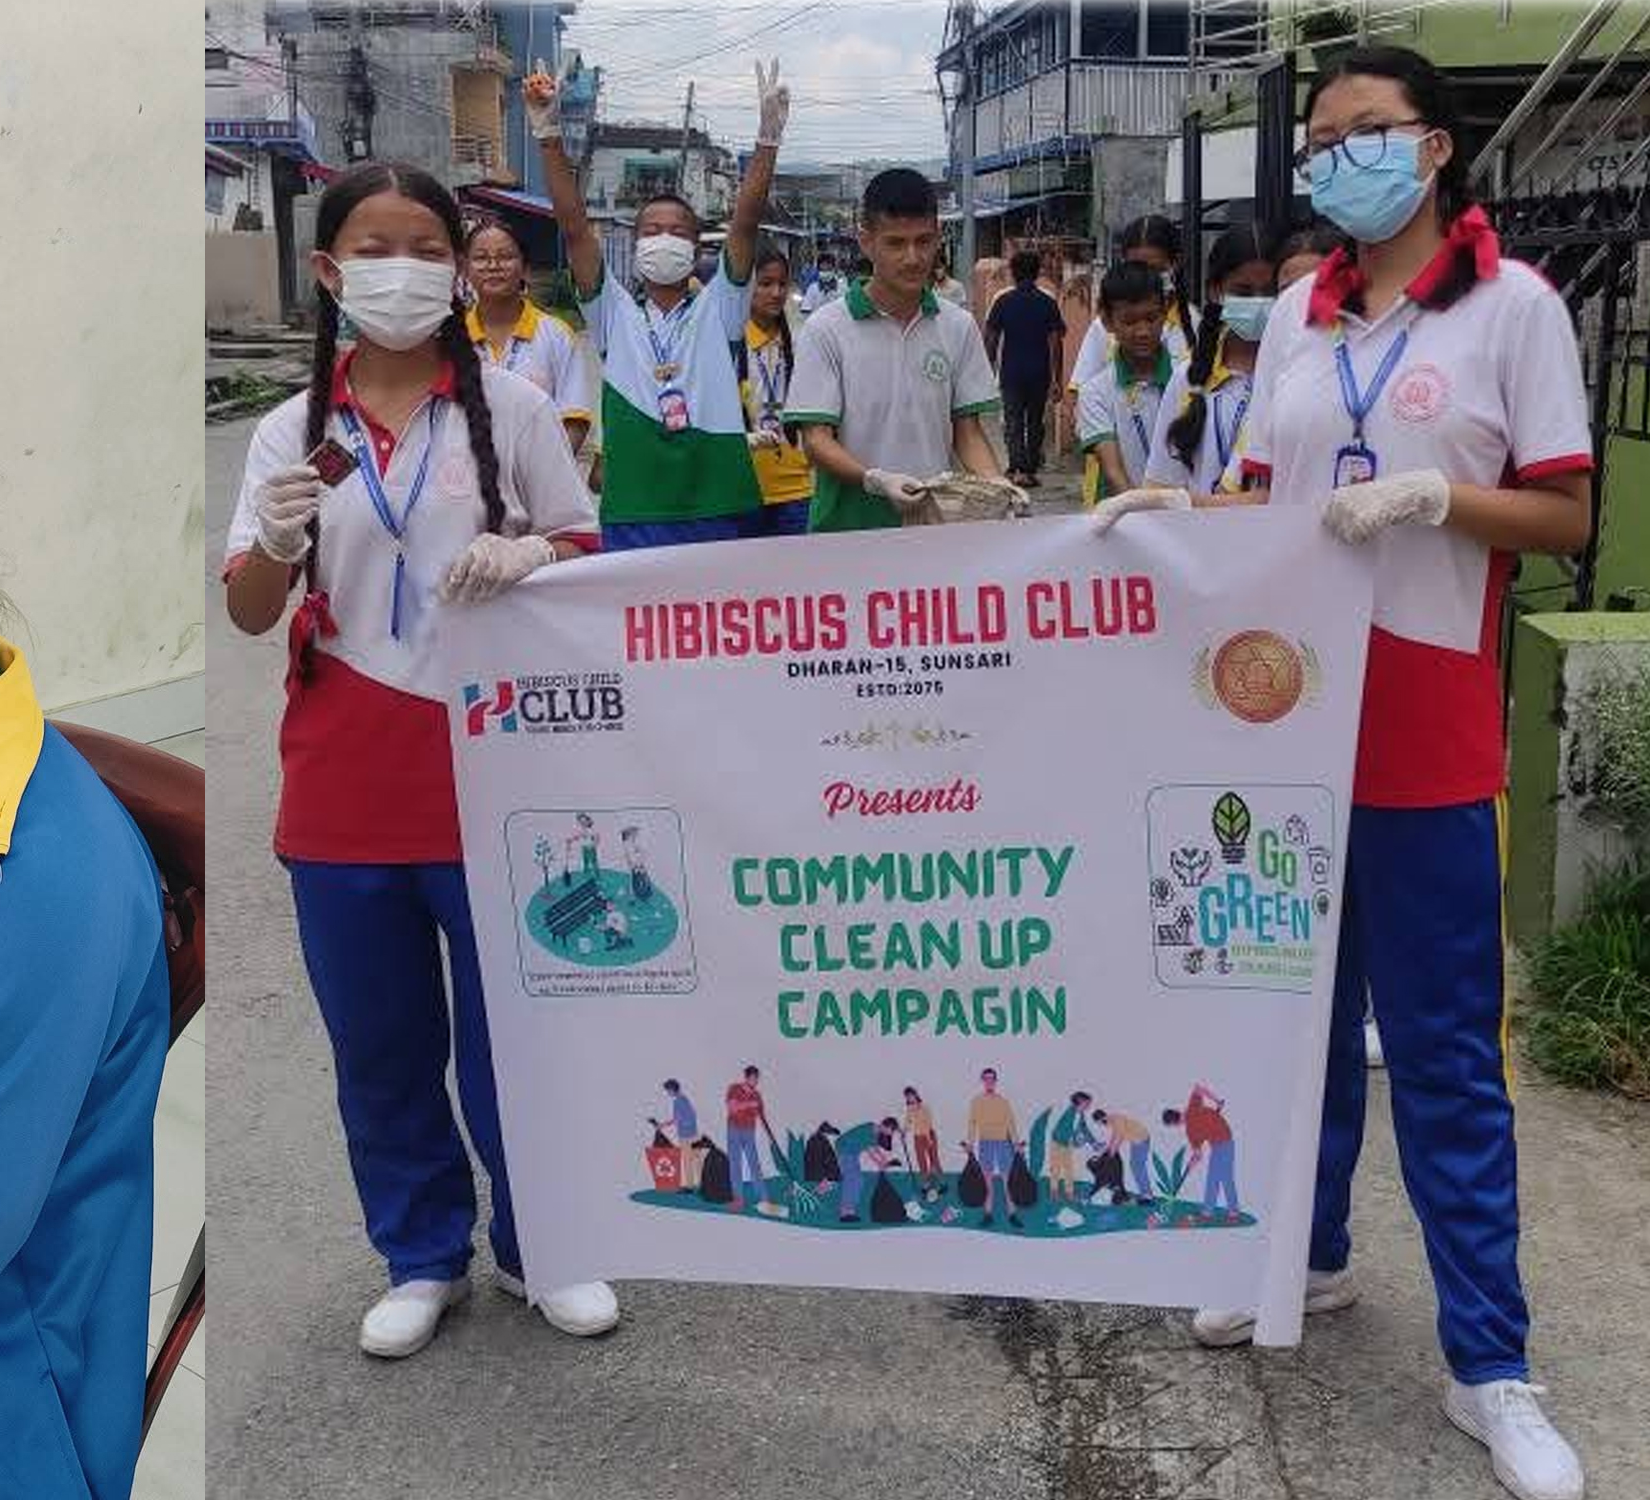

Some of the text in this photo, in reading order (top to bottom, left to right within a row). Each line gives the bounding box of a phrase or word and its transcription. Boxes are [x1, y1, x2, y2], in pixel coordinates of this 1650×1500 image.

[625, 576, 1156, 662] HIBISCUS CHILD CLUB
[788, 652, 1011, 678] DHARAN-15, SUNSARI
[520, 686, 624, 723] CLUB
[823, 778, 982, 819] Presents
[733, 846, 1074, 906] COMMUNITY
[1198, 873, 1311, 948] GREEN
[780, 917, 1052, 972] CLEAN UP
[778, 986, 1066, 1038] CAMPAGIN
